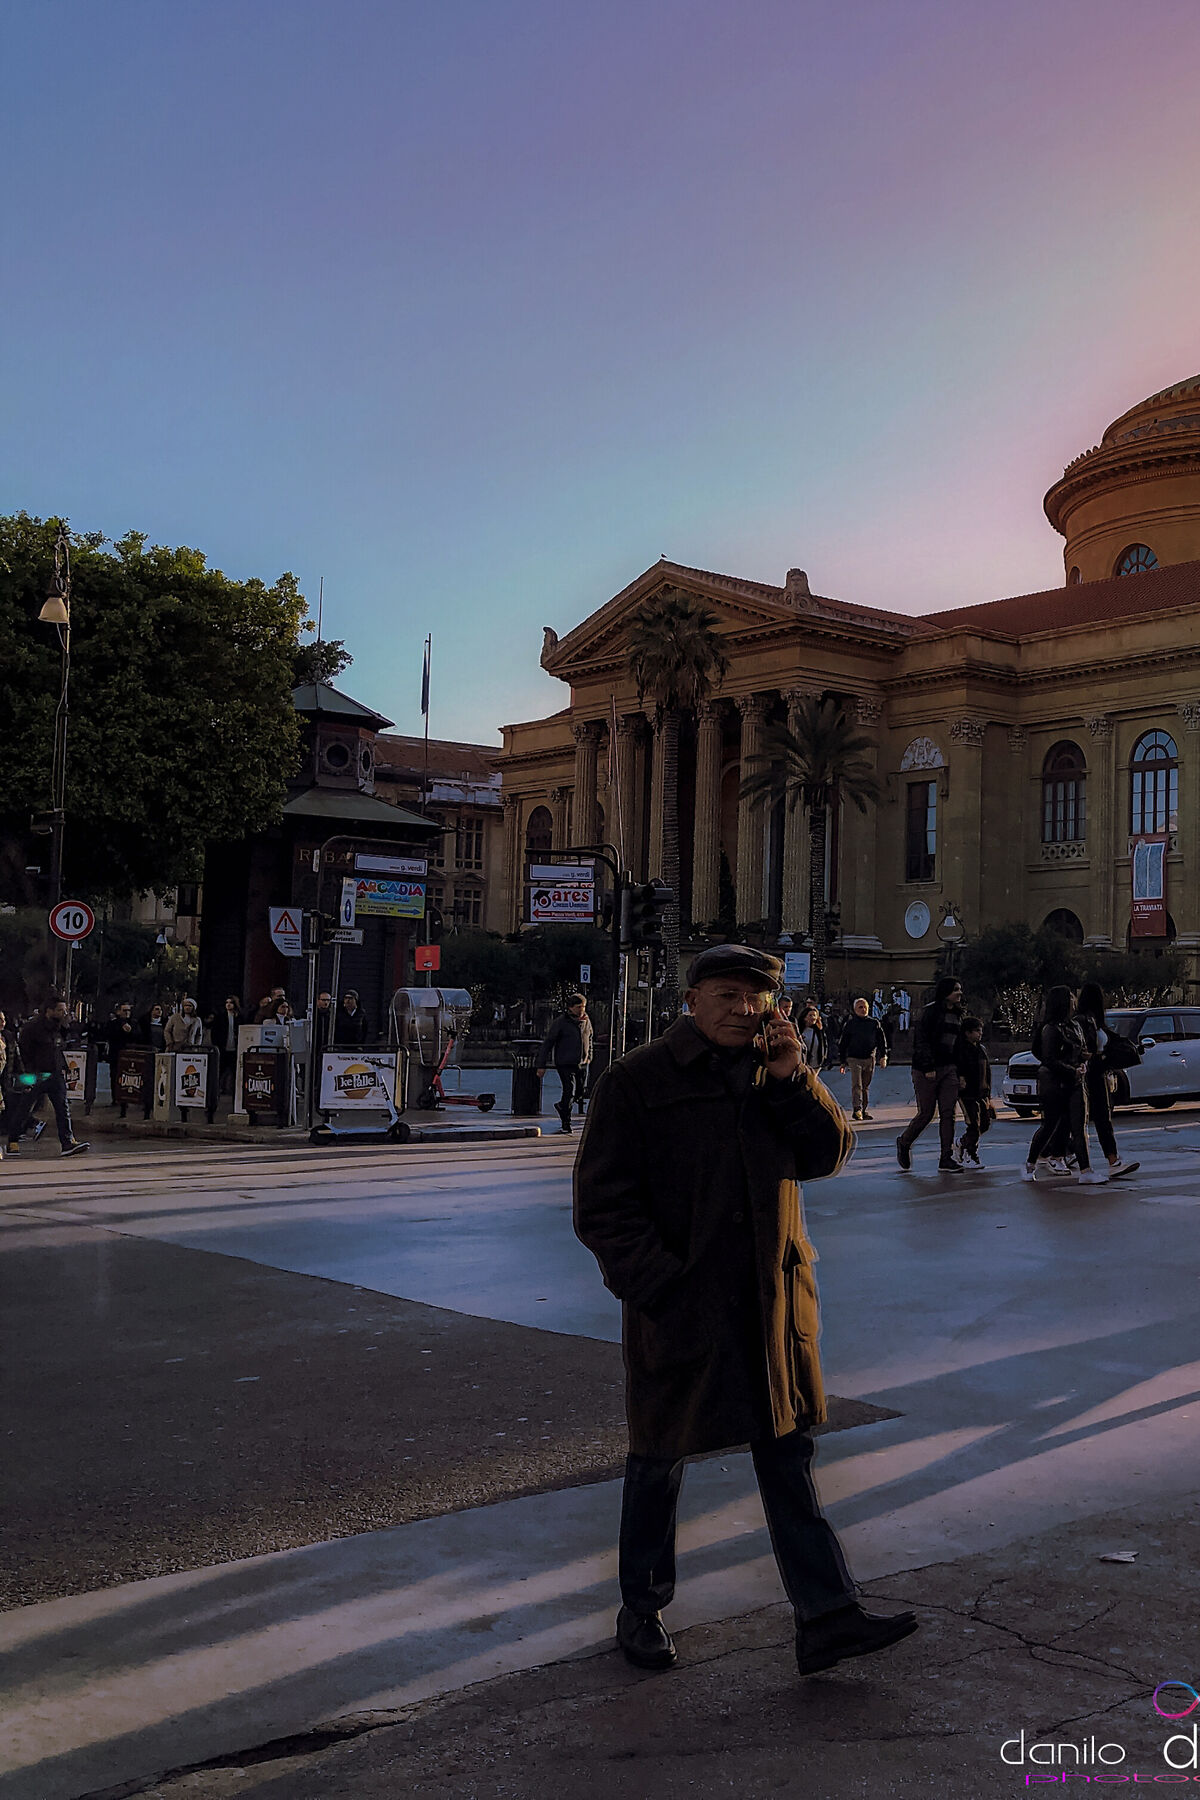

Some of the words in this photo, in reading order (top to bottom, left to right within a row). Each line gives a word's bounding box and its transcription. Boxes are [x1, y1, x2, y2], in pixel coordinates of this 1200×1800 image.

[356, 880, 423, 897] ARCADIA
[552, 890, 589, 902] ares
[1140, 903, 1163, 912] TRAVIATA
[63, 911, 84, 930] 10
